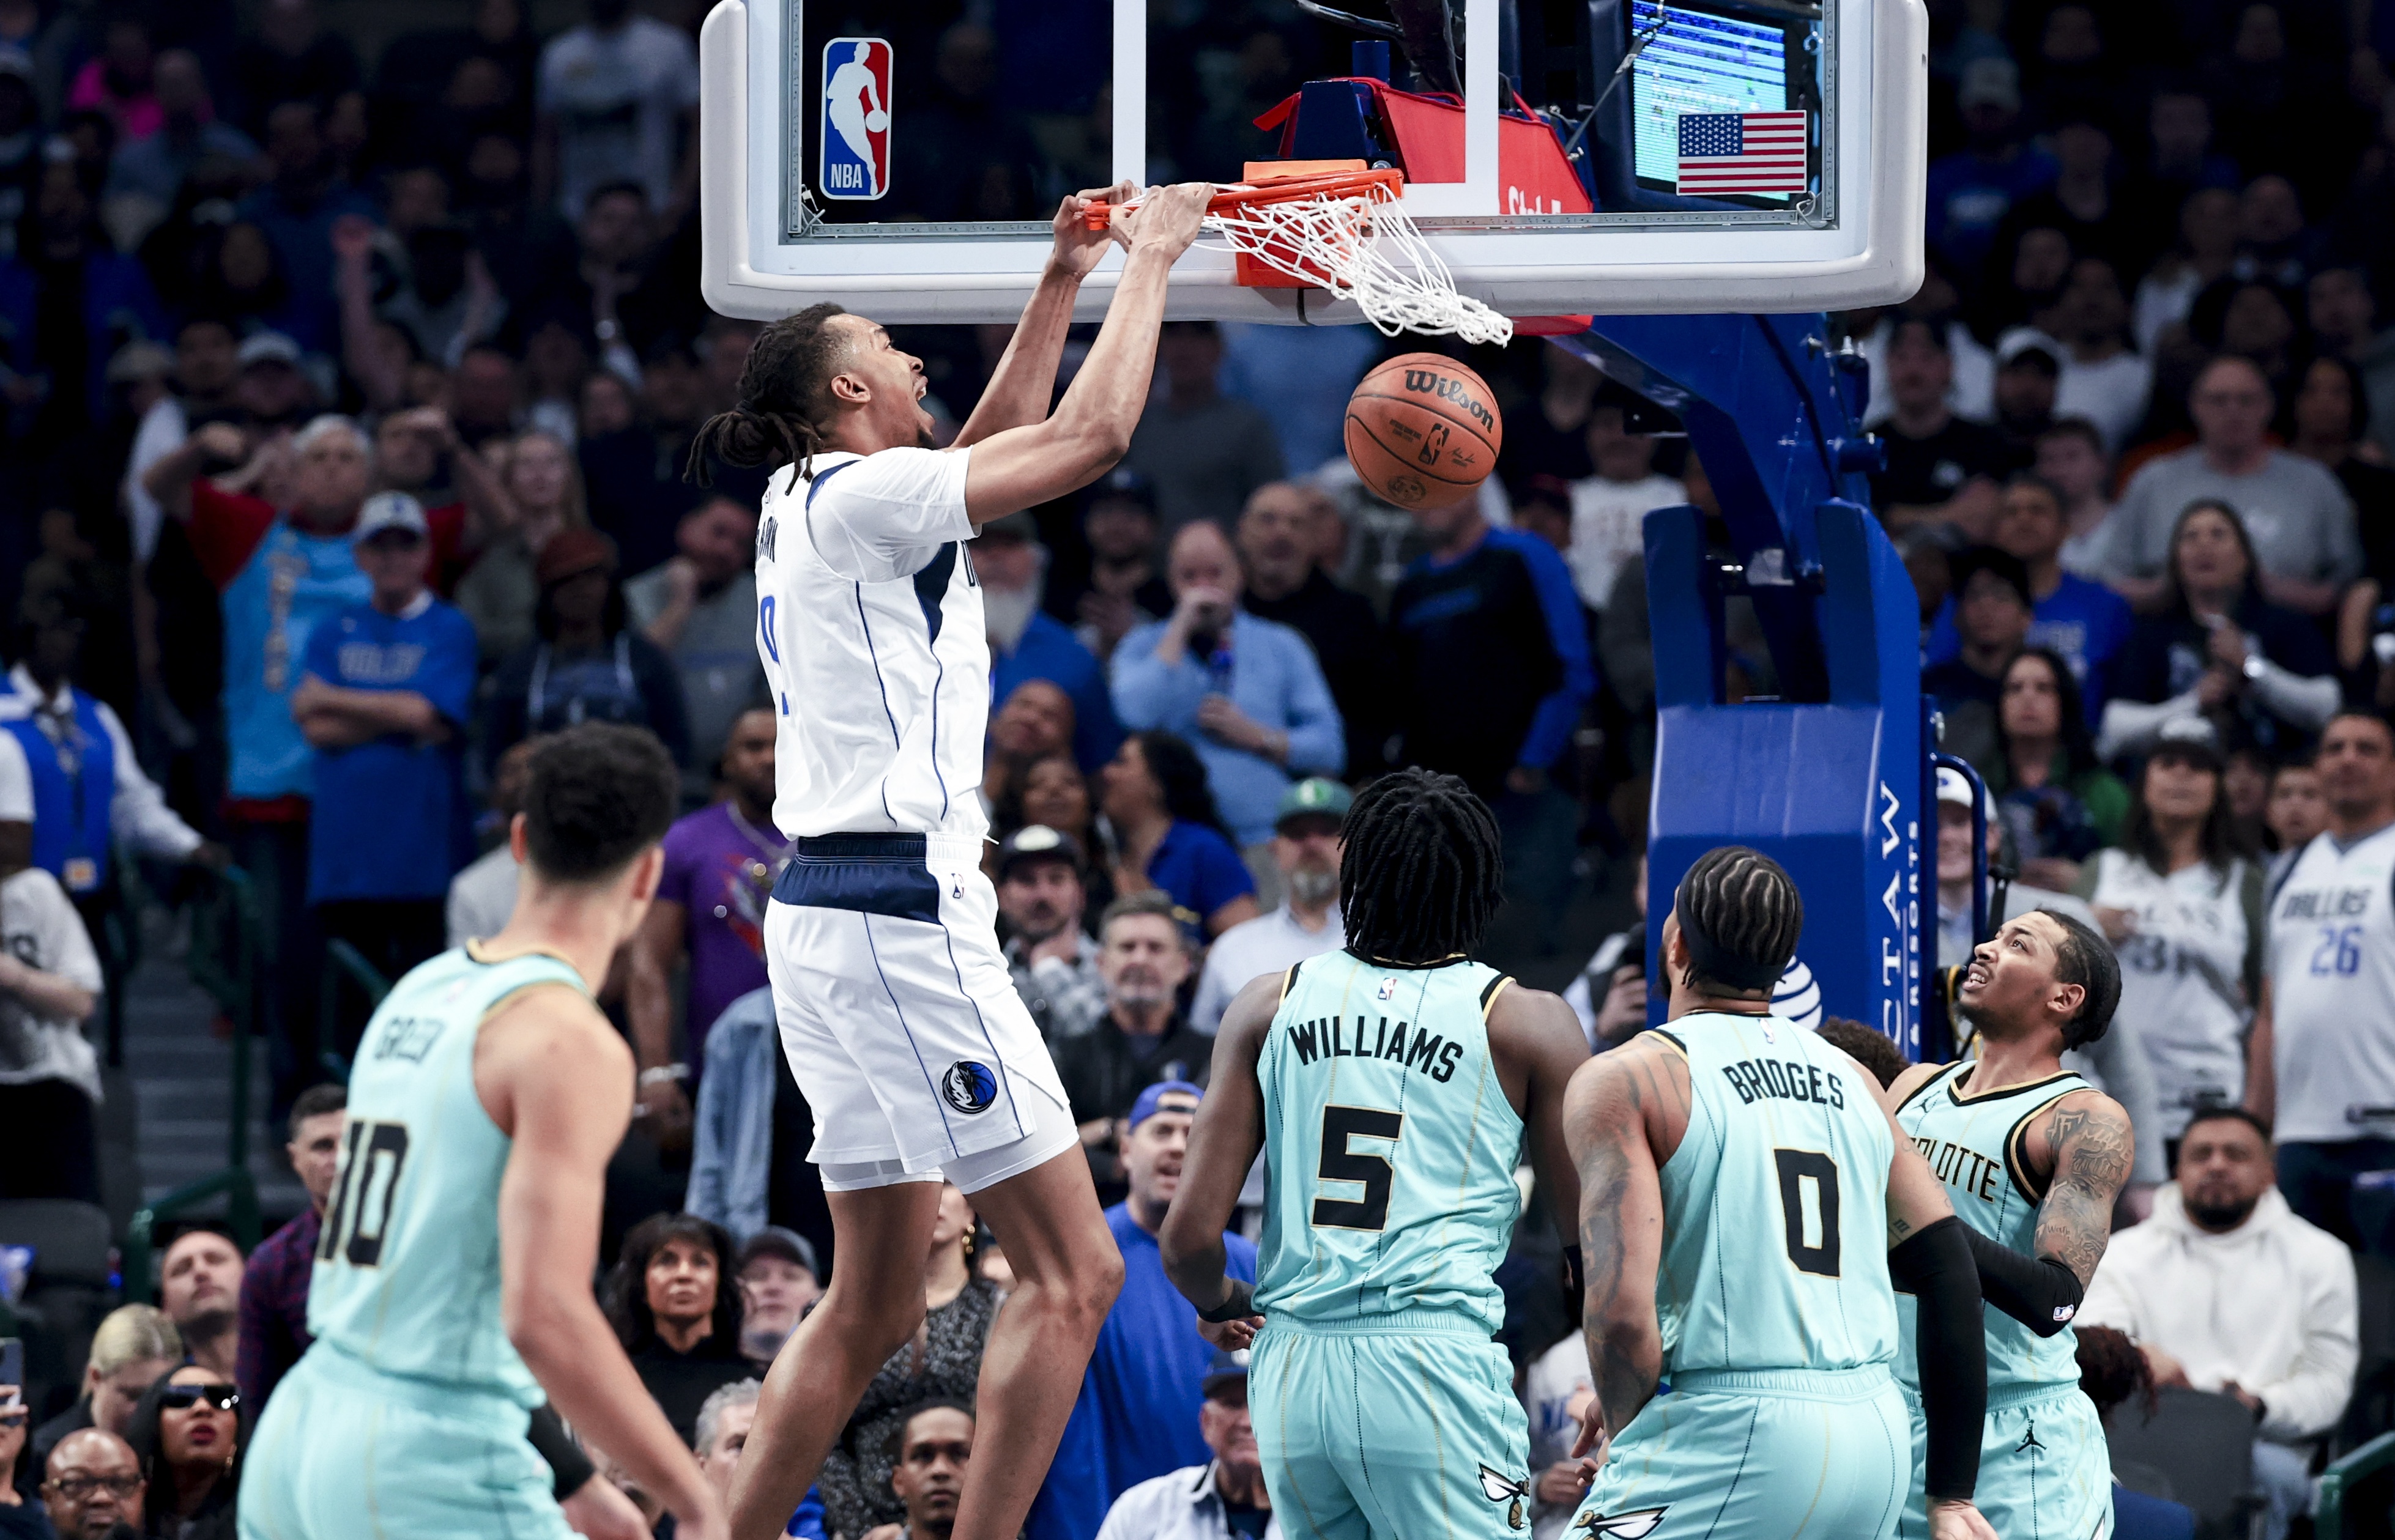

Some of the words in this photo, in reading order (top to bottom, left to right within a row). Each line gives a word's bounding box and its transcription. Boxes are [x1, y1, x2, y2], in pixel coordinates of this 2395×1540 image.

[831, 163, 863, 188] NBA
[1405, 369, 1494, 434] Wilson
[2310, 926, 2364, 975] 26
[1288, 1015, 1463, 1083] WILLIAMS
[1721, 1058, 1844, 1111] BRIDGES
[319, 1120, 409, 1268] 10
[1310, 1103, 1405, 1234] 5
[1773, 1147, 1842, 1279] 0
